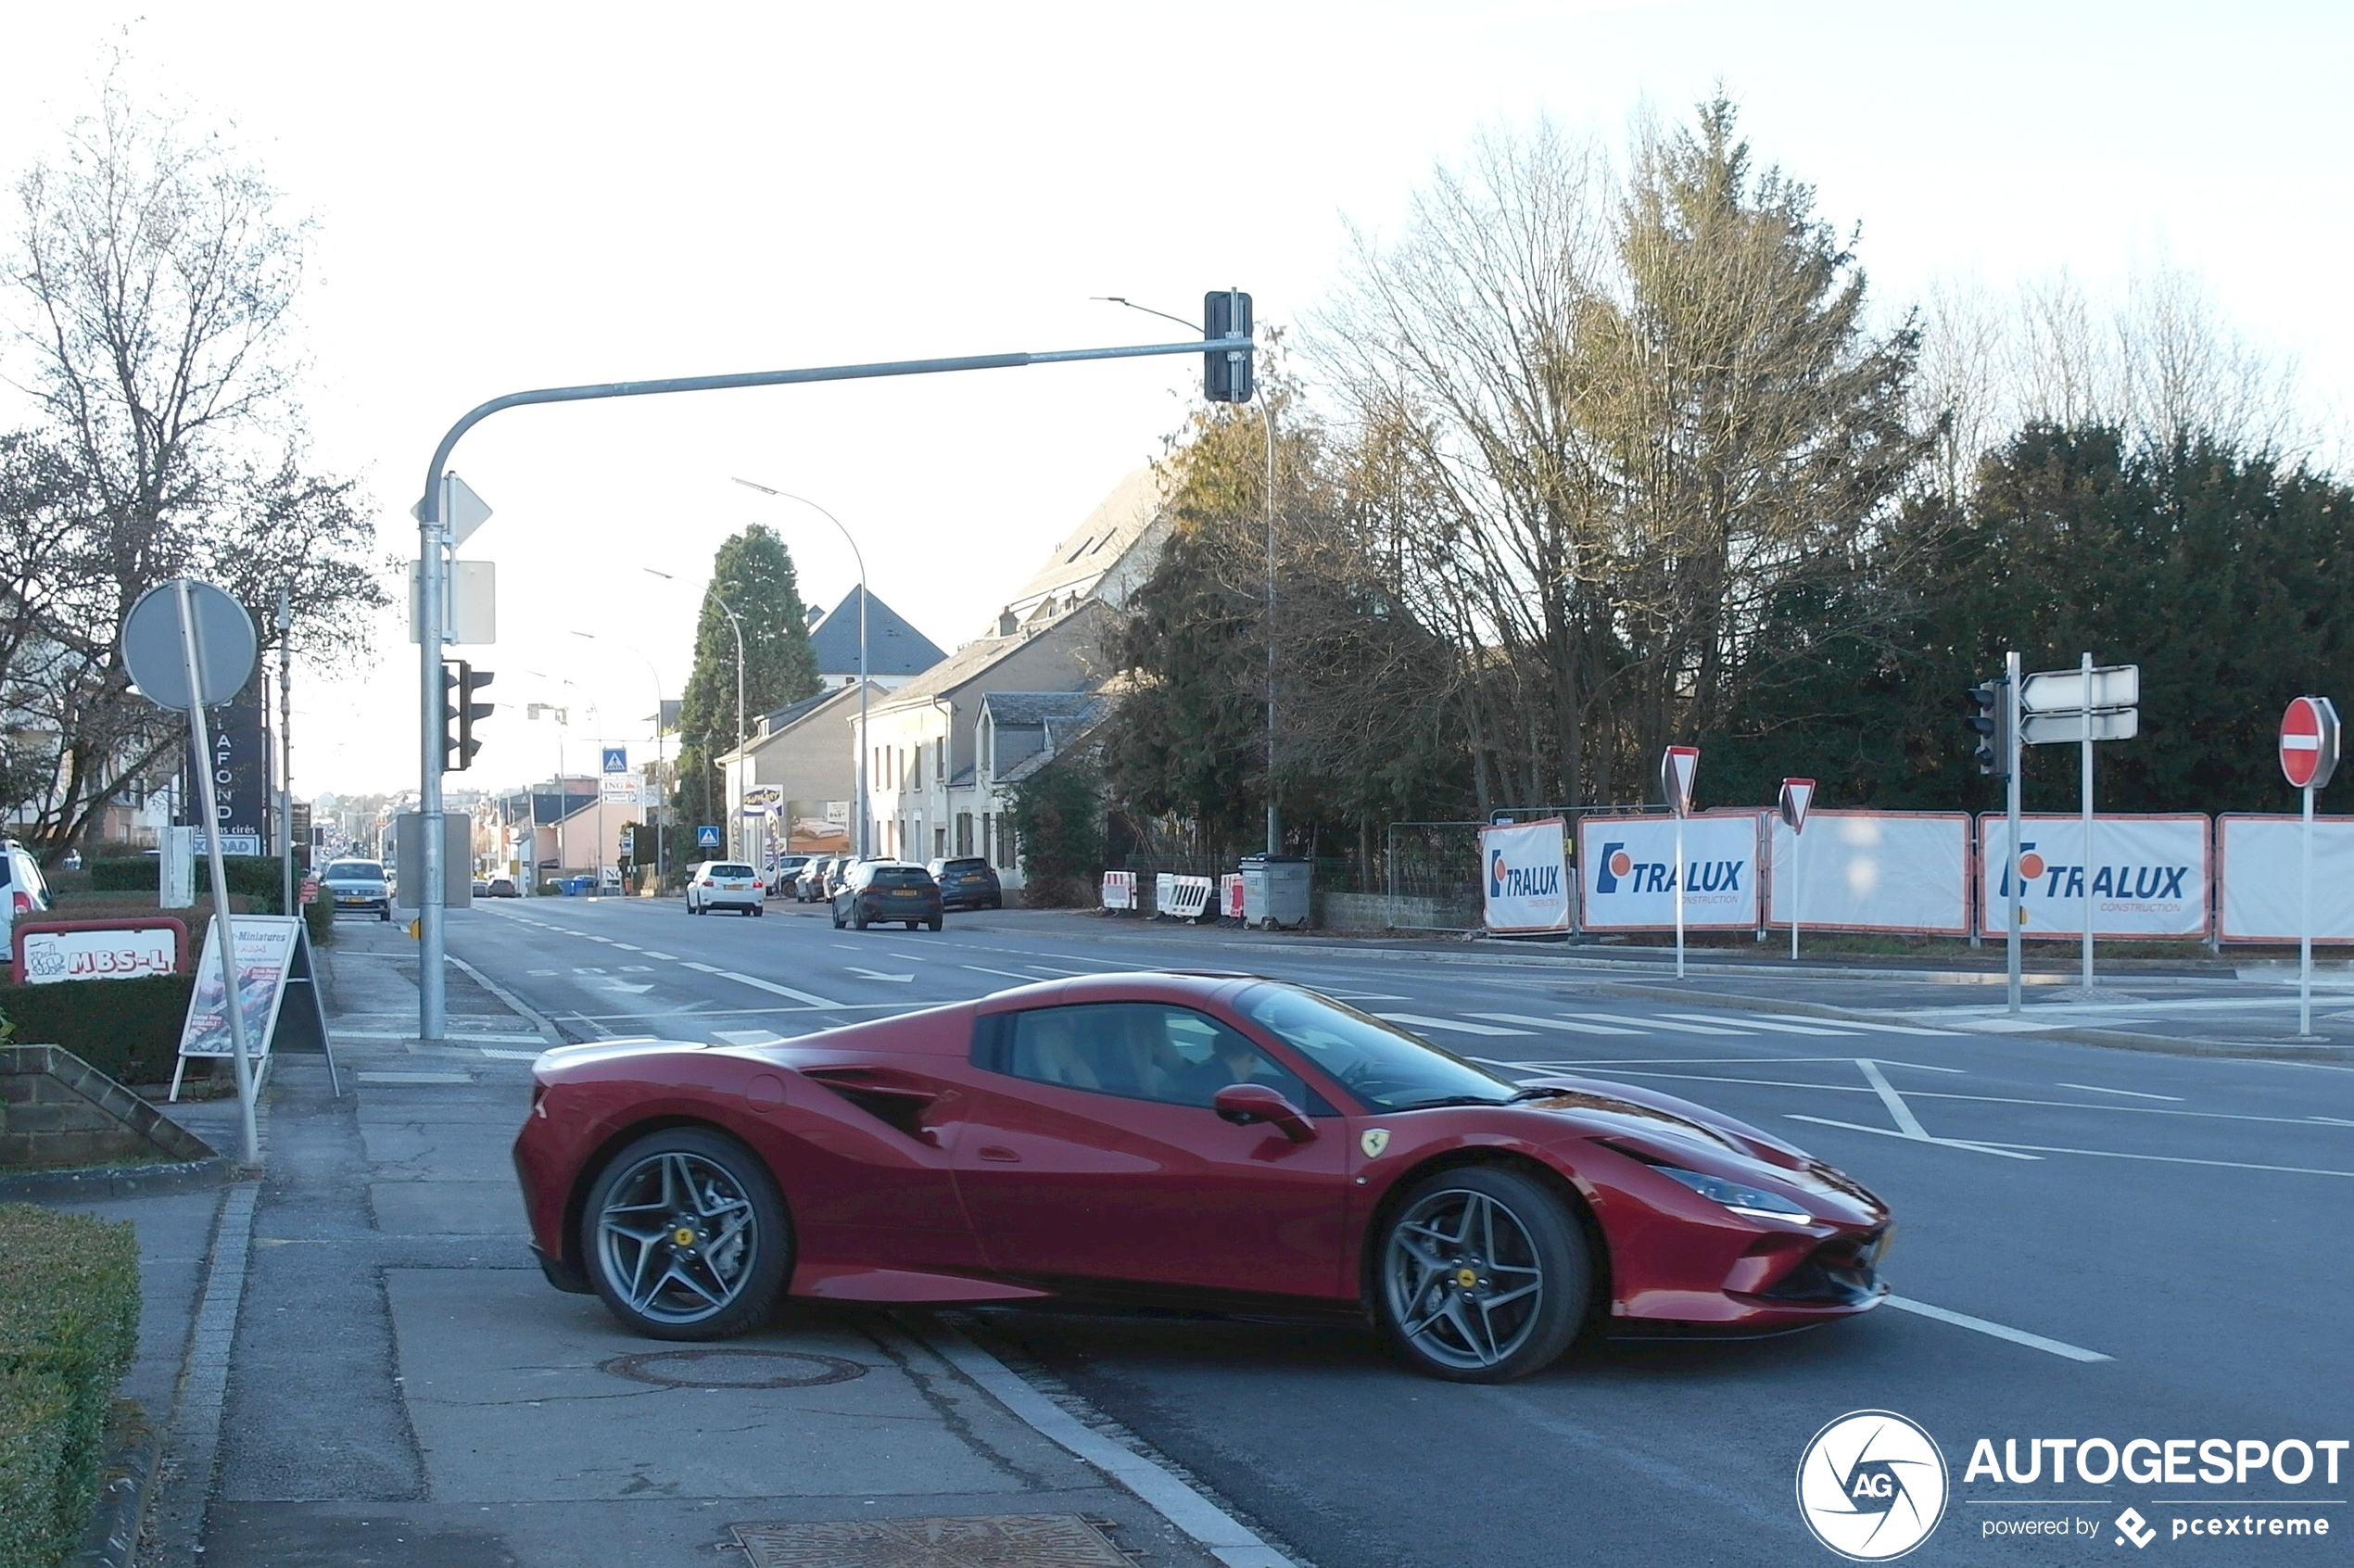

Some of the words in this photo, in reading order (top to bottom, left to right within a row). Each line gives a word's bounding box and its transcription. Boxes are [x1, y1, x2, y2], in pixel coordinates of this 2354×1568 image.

[604, 781, 624, 790] ING
[193, 824, 229, 834] Béns
[231, 824, 256, 834] cirés
[1506, 865, 1559, 897] TRALUX
[1632, 860, 1744, 892] TRALUX
[2046, 866, 2188, 899] TRALUX
[1527, 899, 1559, 908] CONSTRUCTION
[1675, 895, 1739, 904] ONSTRUCTION
[2100, 903, 2182, 912] CONSTRUCTION
[69, 949, 169, 974] MBS-L
